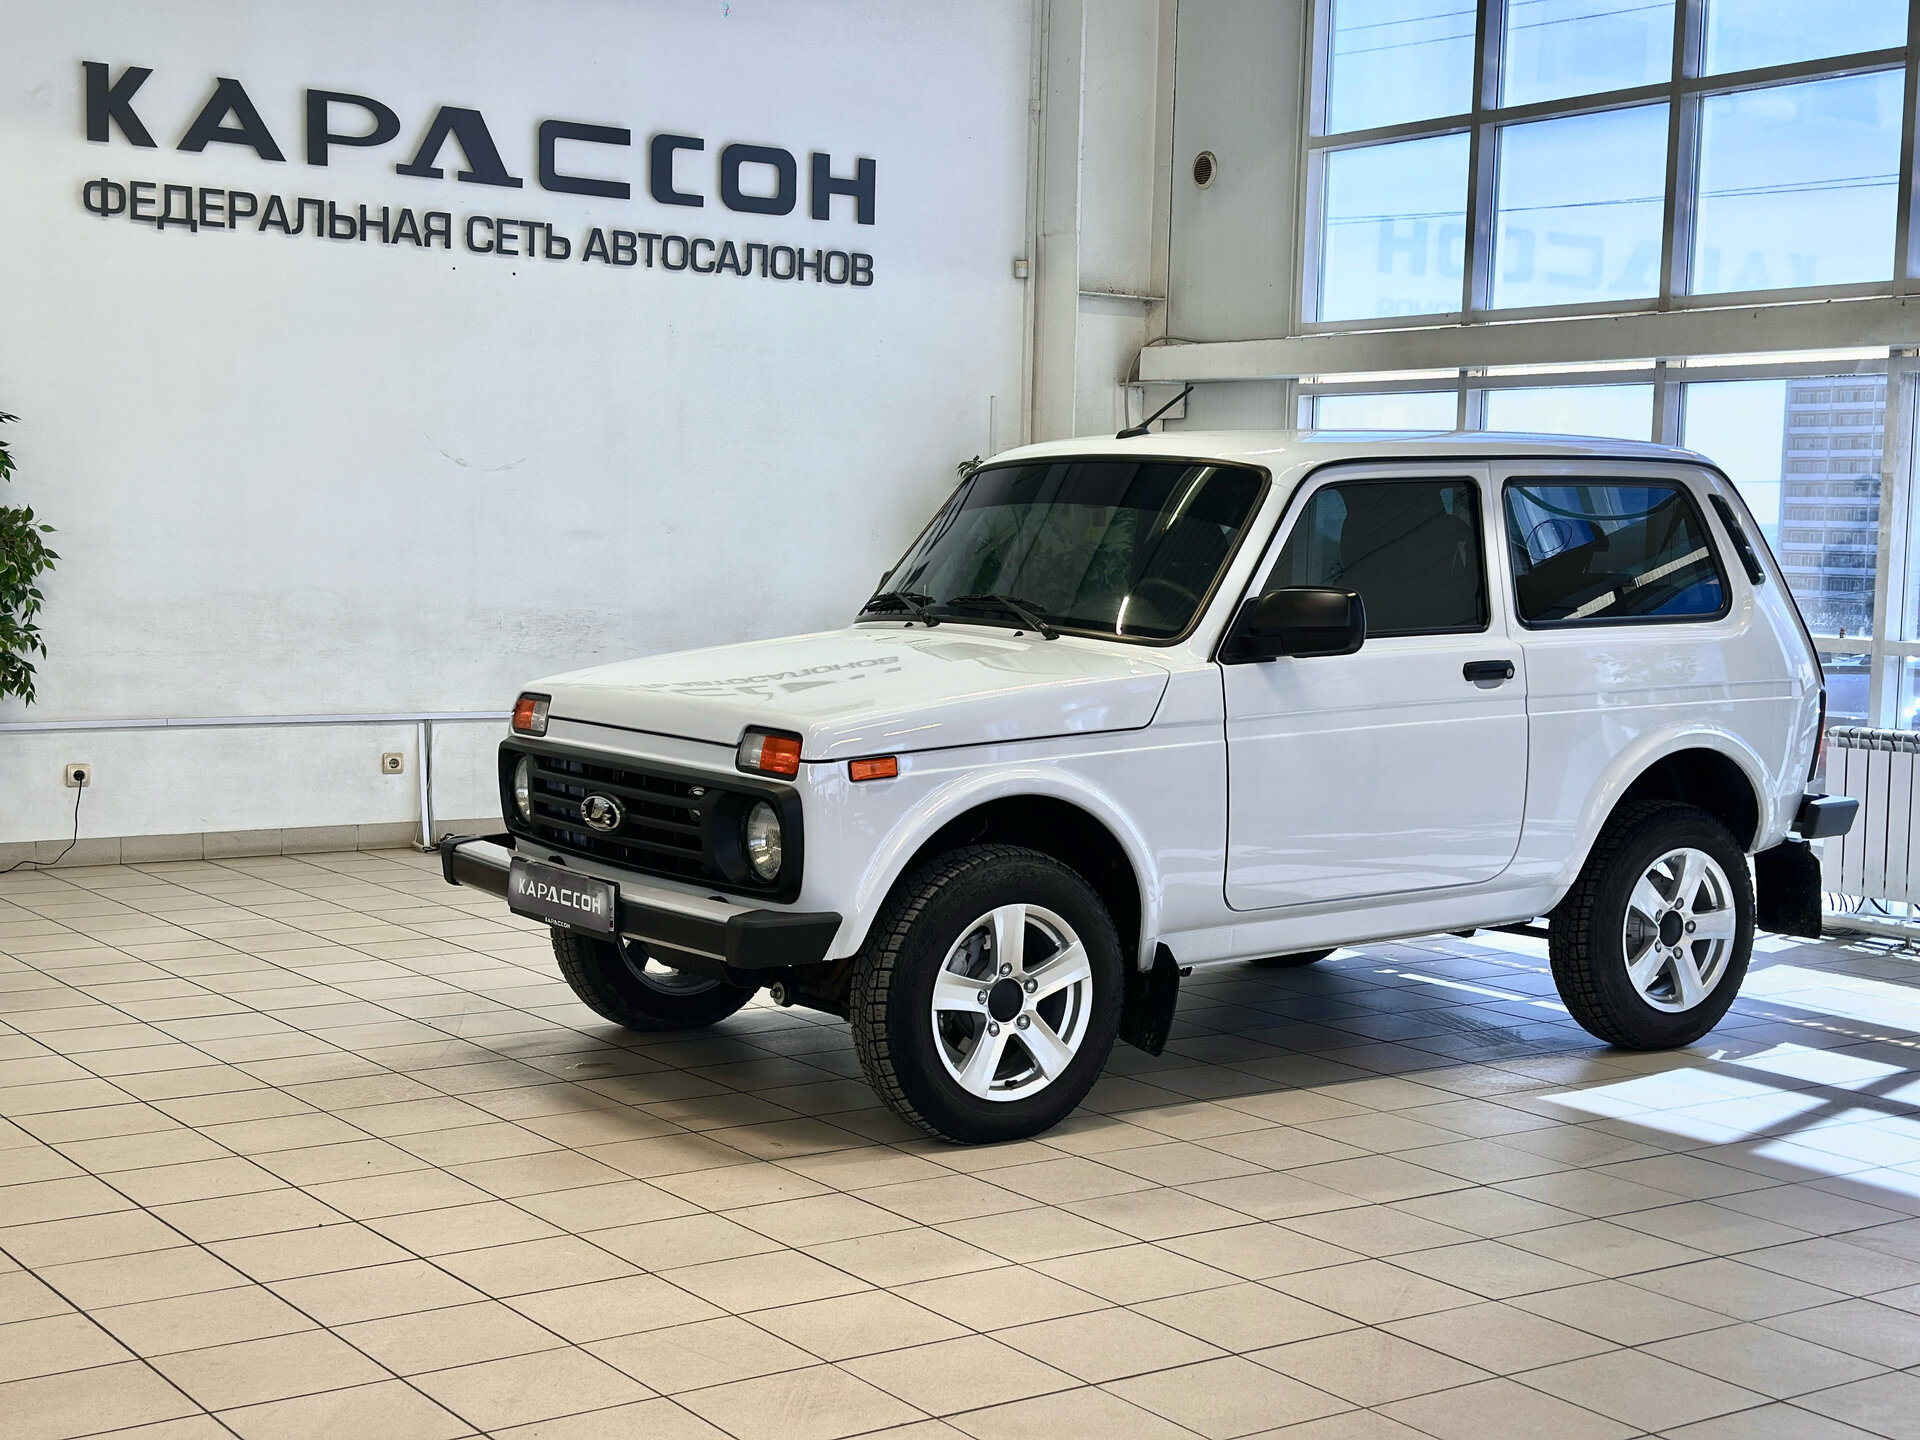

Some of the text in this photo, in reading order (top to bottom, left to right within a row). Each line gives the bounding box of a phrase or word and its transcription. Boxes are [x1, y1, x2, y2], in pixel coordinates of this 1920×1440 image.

[82, 177, 874, 287] ФЕДЕРАЛЬНАЯ СЕТЬ АВТОСАЛОНОВ
